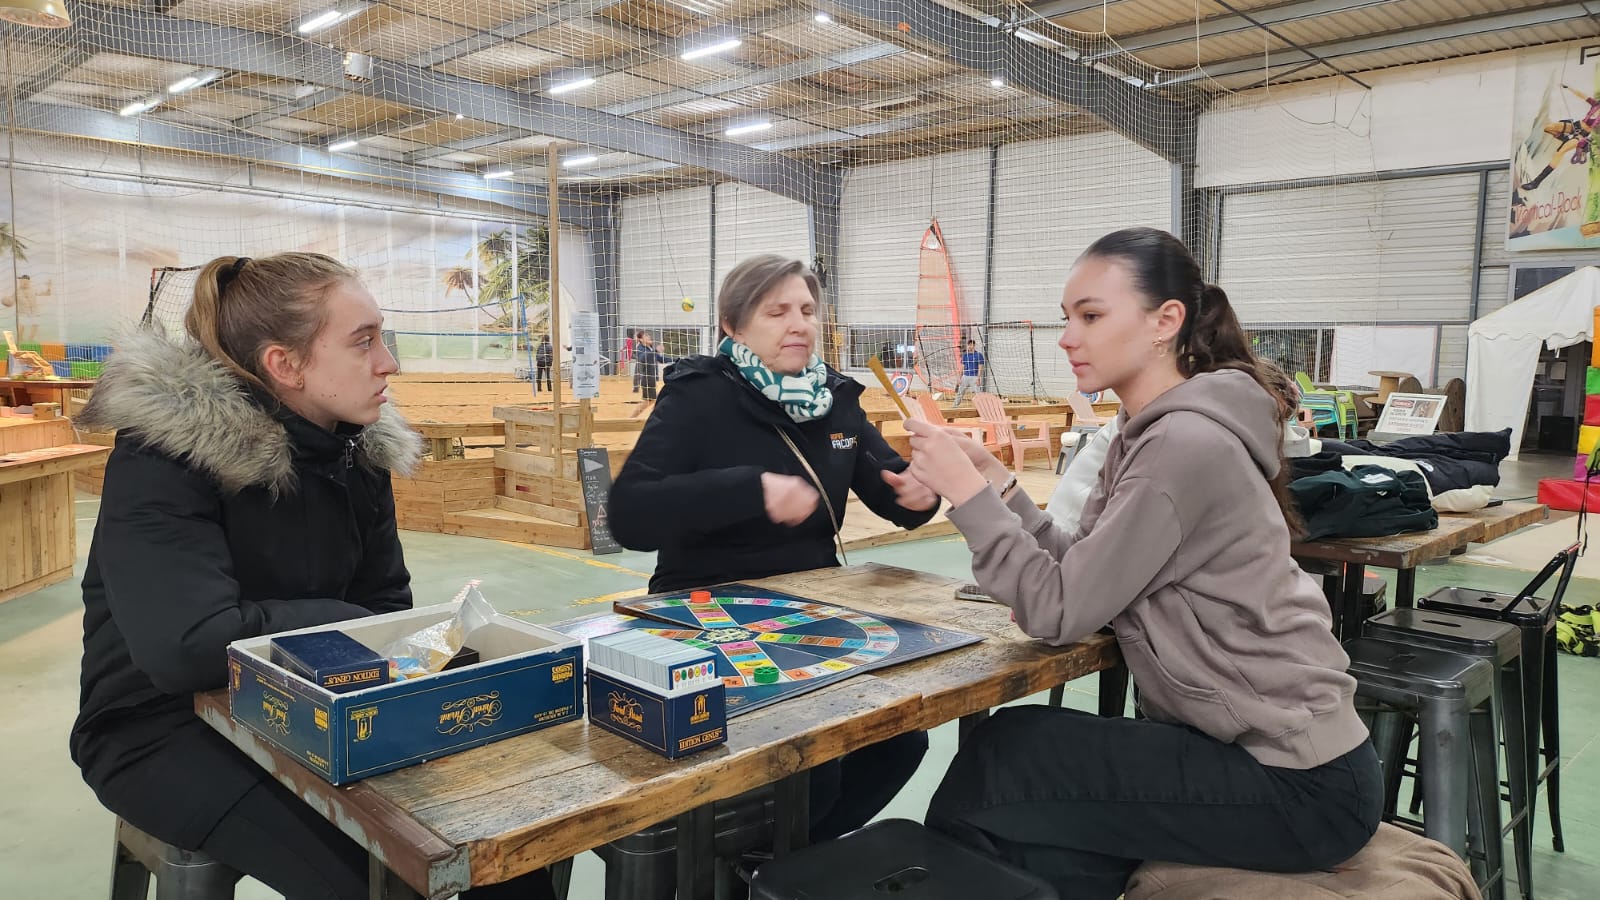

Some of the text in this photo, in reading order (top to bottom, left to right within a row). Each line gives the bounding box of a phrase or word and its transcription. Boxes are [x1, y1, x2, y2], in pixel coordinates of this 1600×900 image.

[1515, 186, 1582, 222] Veical-Rock
[353, 670, 380, 681] EDITION
[680, 735, 701, 749] EDITION
